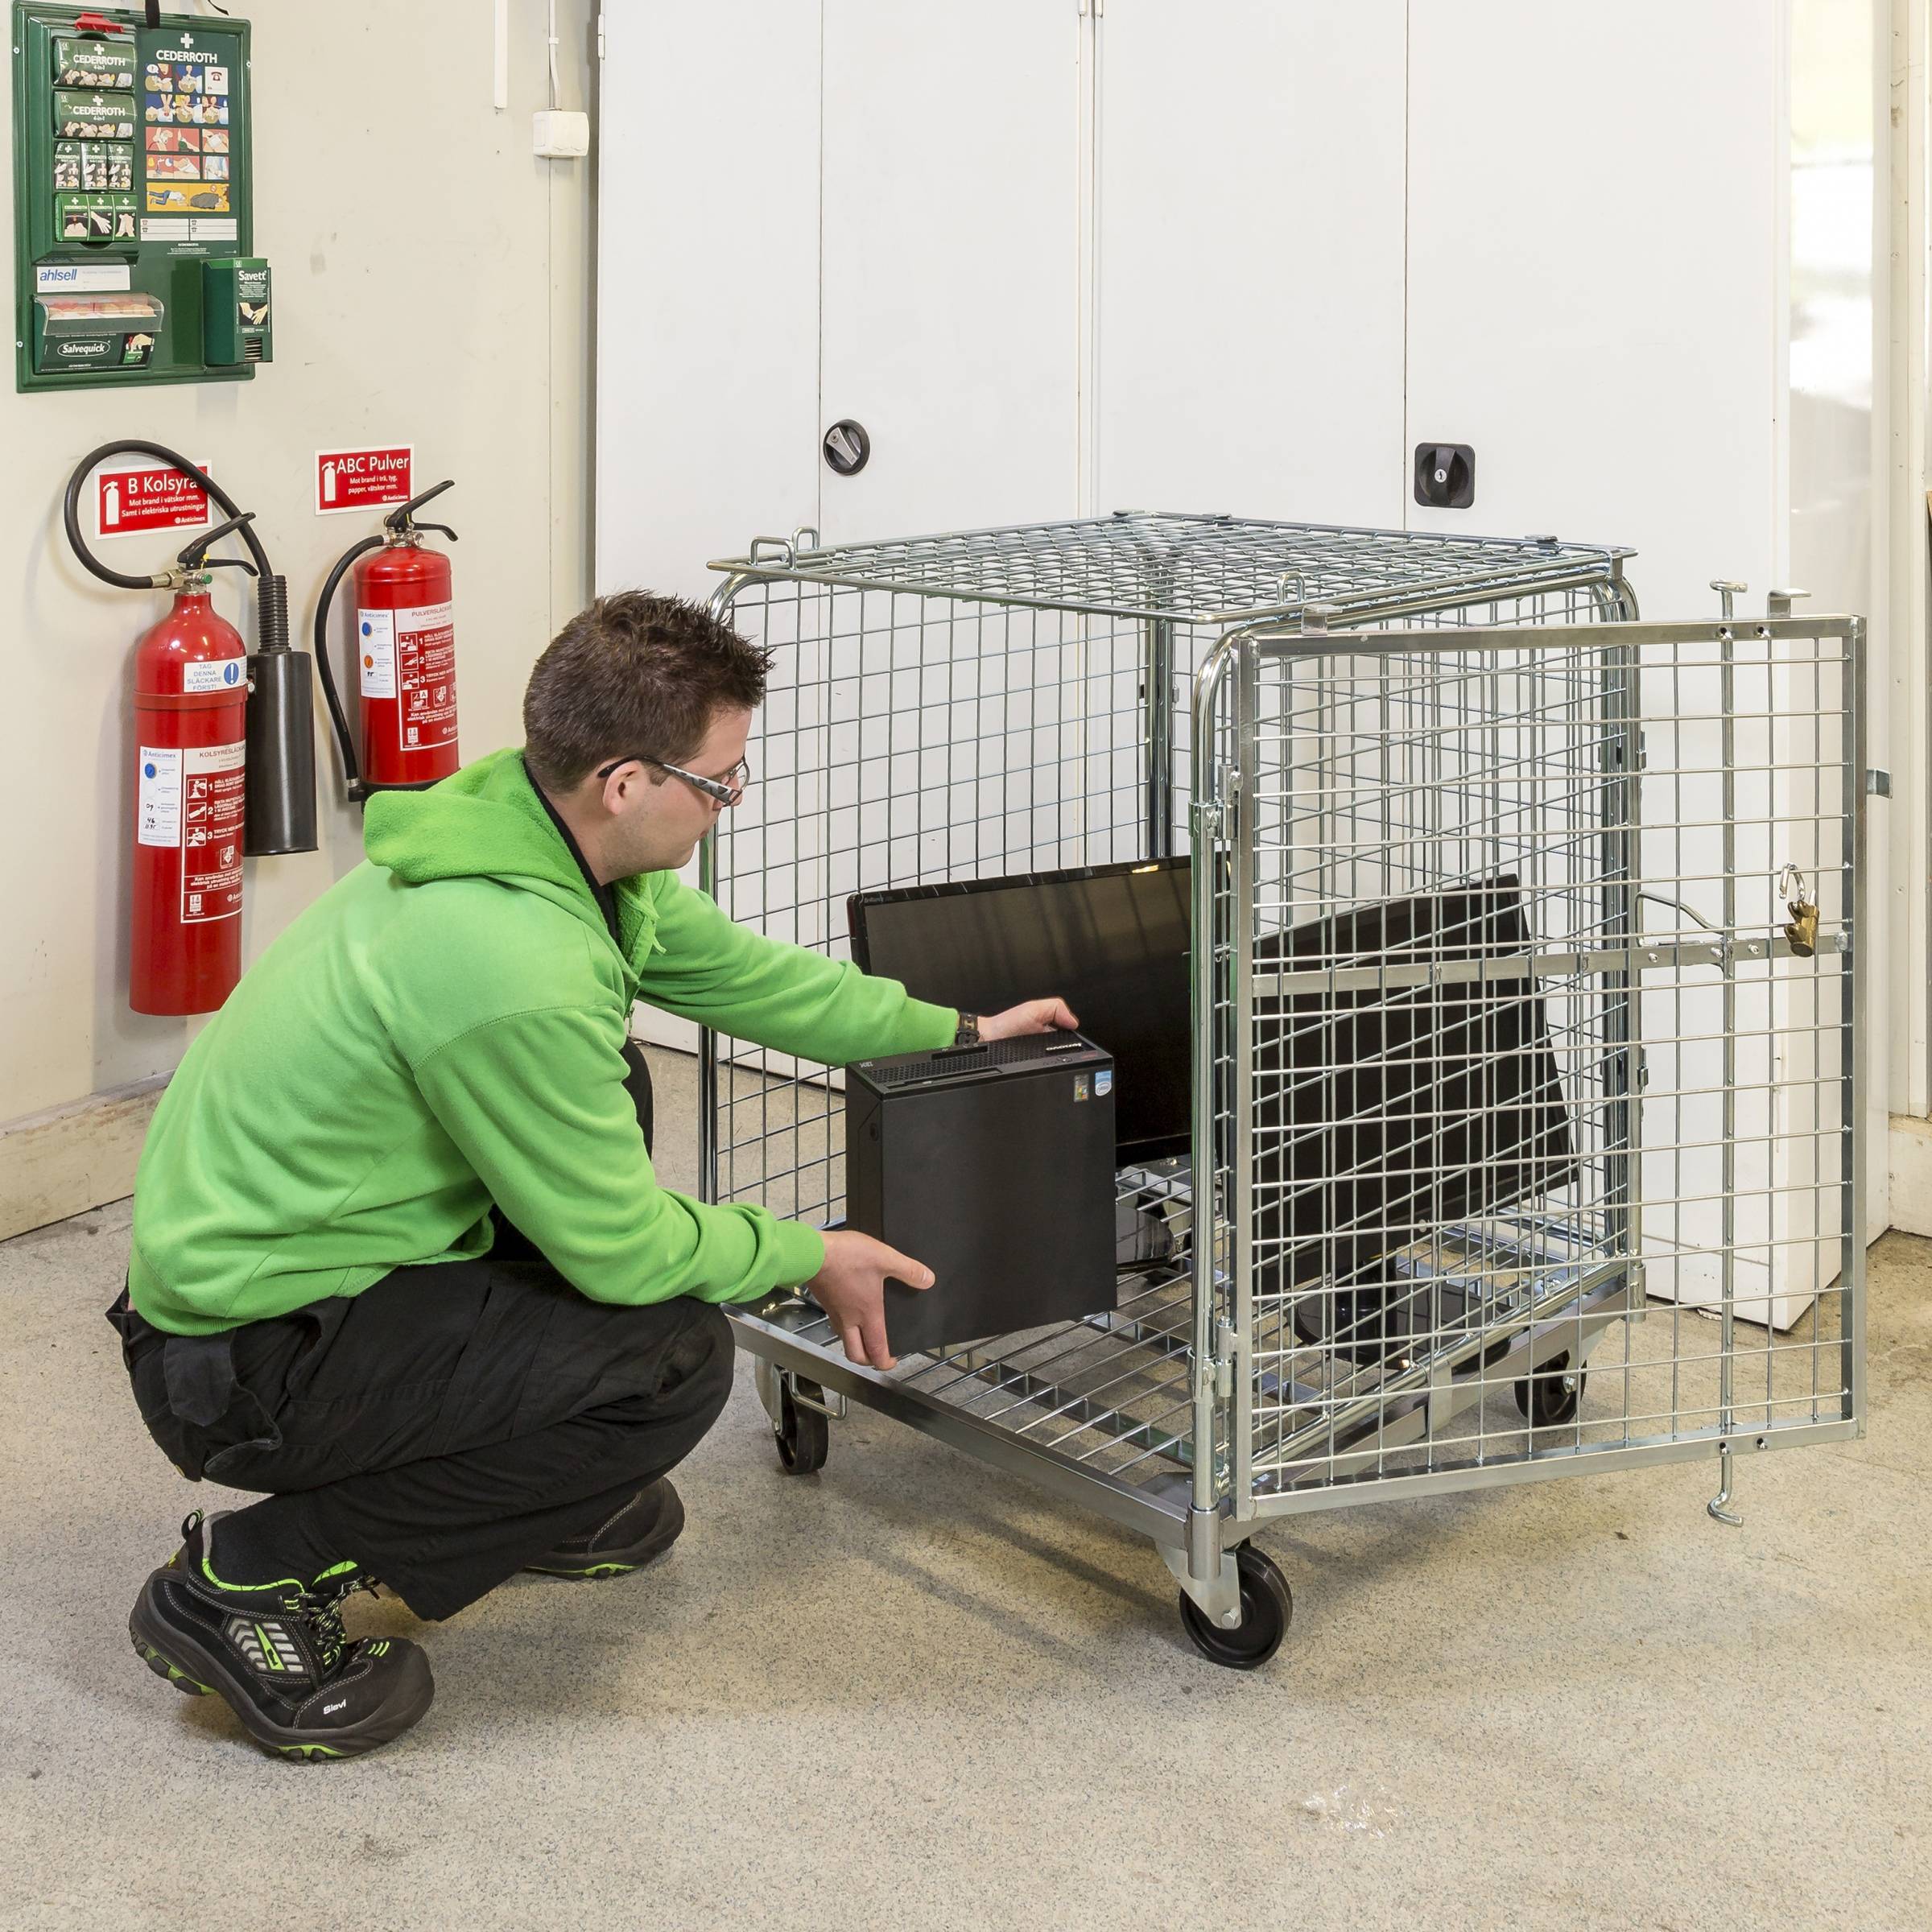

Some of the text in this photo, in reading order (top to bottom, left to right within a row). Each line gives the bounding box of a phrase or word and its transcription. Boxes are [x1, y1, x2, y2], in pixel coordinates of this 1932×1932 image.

[73, 54, 126, 66] CEDERROTH
[155, 50, 217, 64] CEDERROTH
[72, 105, 126, 116] CEDERROTH
[39, 268, 77, 282] ahlsell
[238, 270, 266, 281] Savett
[62, 343, 105, 355] Salvequick
[336, 453, 409, 474] ABC Pulver
[128, 473, 198, 495] B Kolsyra
[361, 476, 376, 484] brand
[129, 499, 142, 507] Mot
[122, 509, 138, 518] Samt
[141, 506, 169, 515] elektriska
[170, 503, 206, 513] utrustningar
[419, 656, 425, 664] 2
[187, 676, 222, 684] SLÄCKARE
[419, 675, 426, 683] 3
[208, 782, 213, 791] 1
[208, 807, 213, 815] 2
[207, 831, 213, 840] 3
[323, 1699, 346, 1715] Sievi
